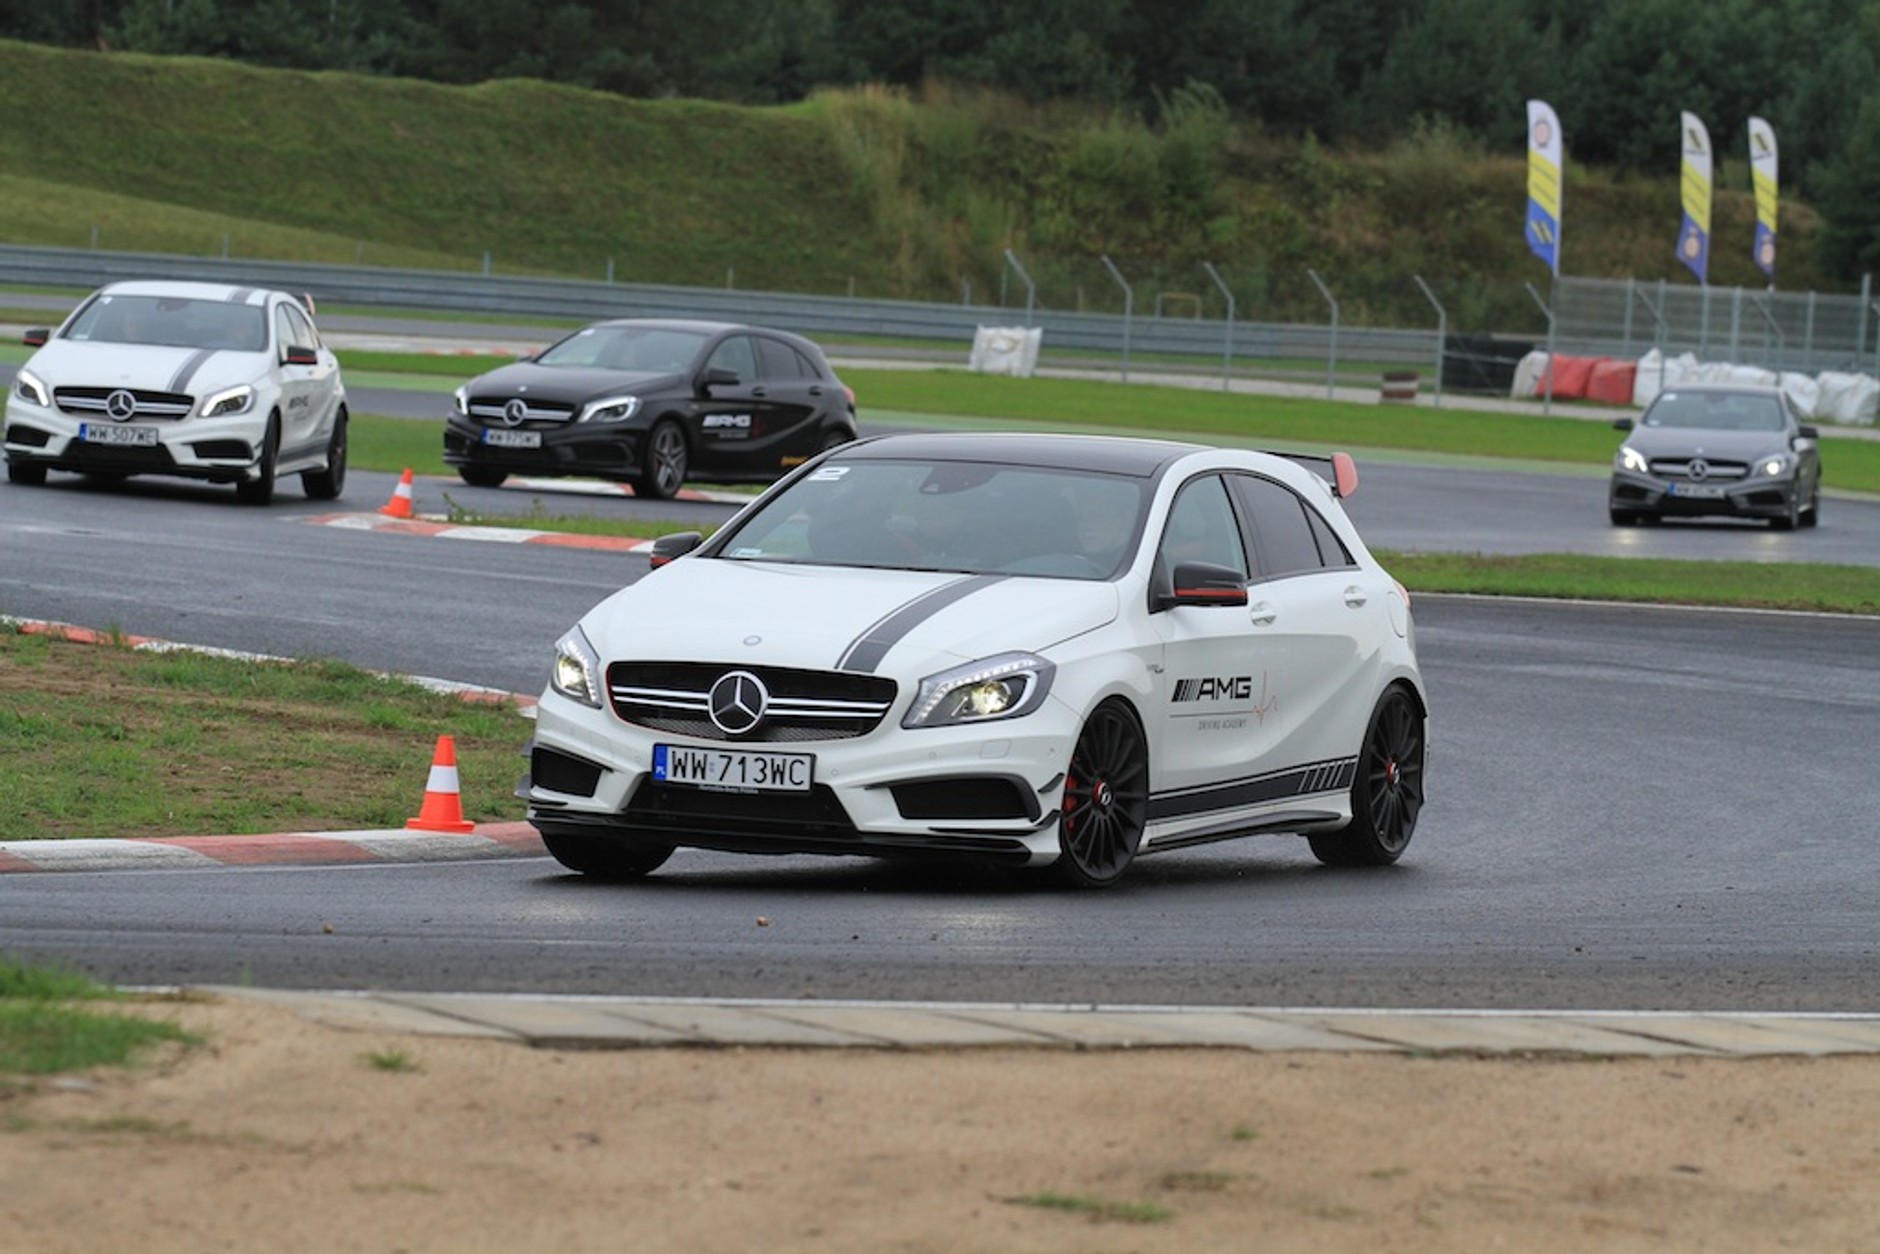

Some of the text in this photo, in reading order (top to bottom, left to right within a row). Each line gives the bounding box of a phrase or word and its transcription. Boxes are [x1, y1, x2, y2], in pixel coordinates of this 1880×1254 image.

[808, 466, 851, 481] 2
[1196, 676, 1251, 701] AMG
[1198, 719, 1221, 731] DRIVING
[655, 766, 666, 776] PL
[672, 751, 806, 786] WW 713WC
